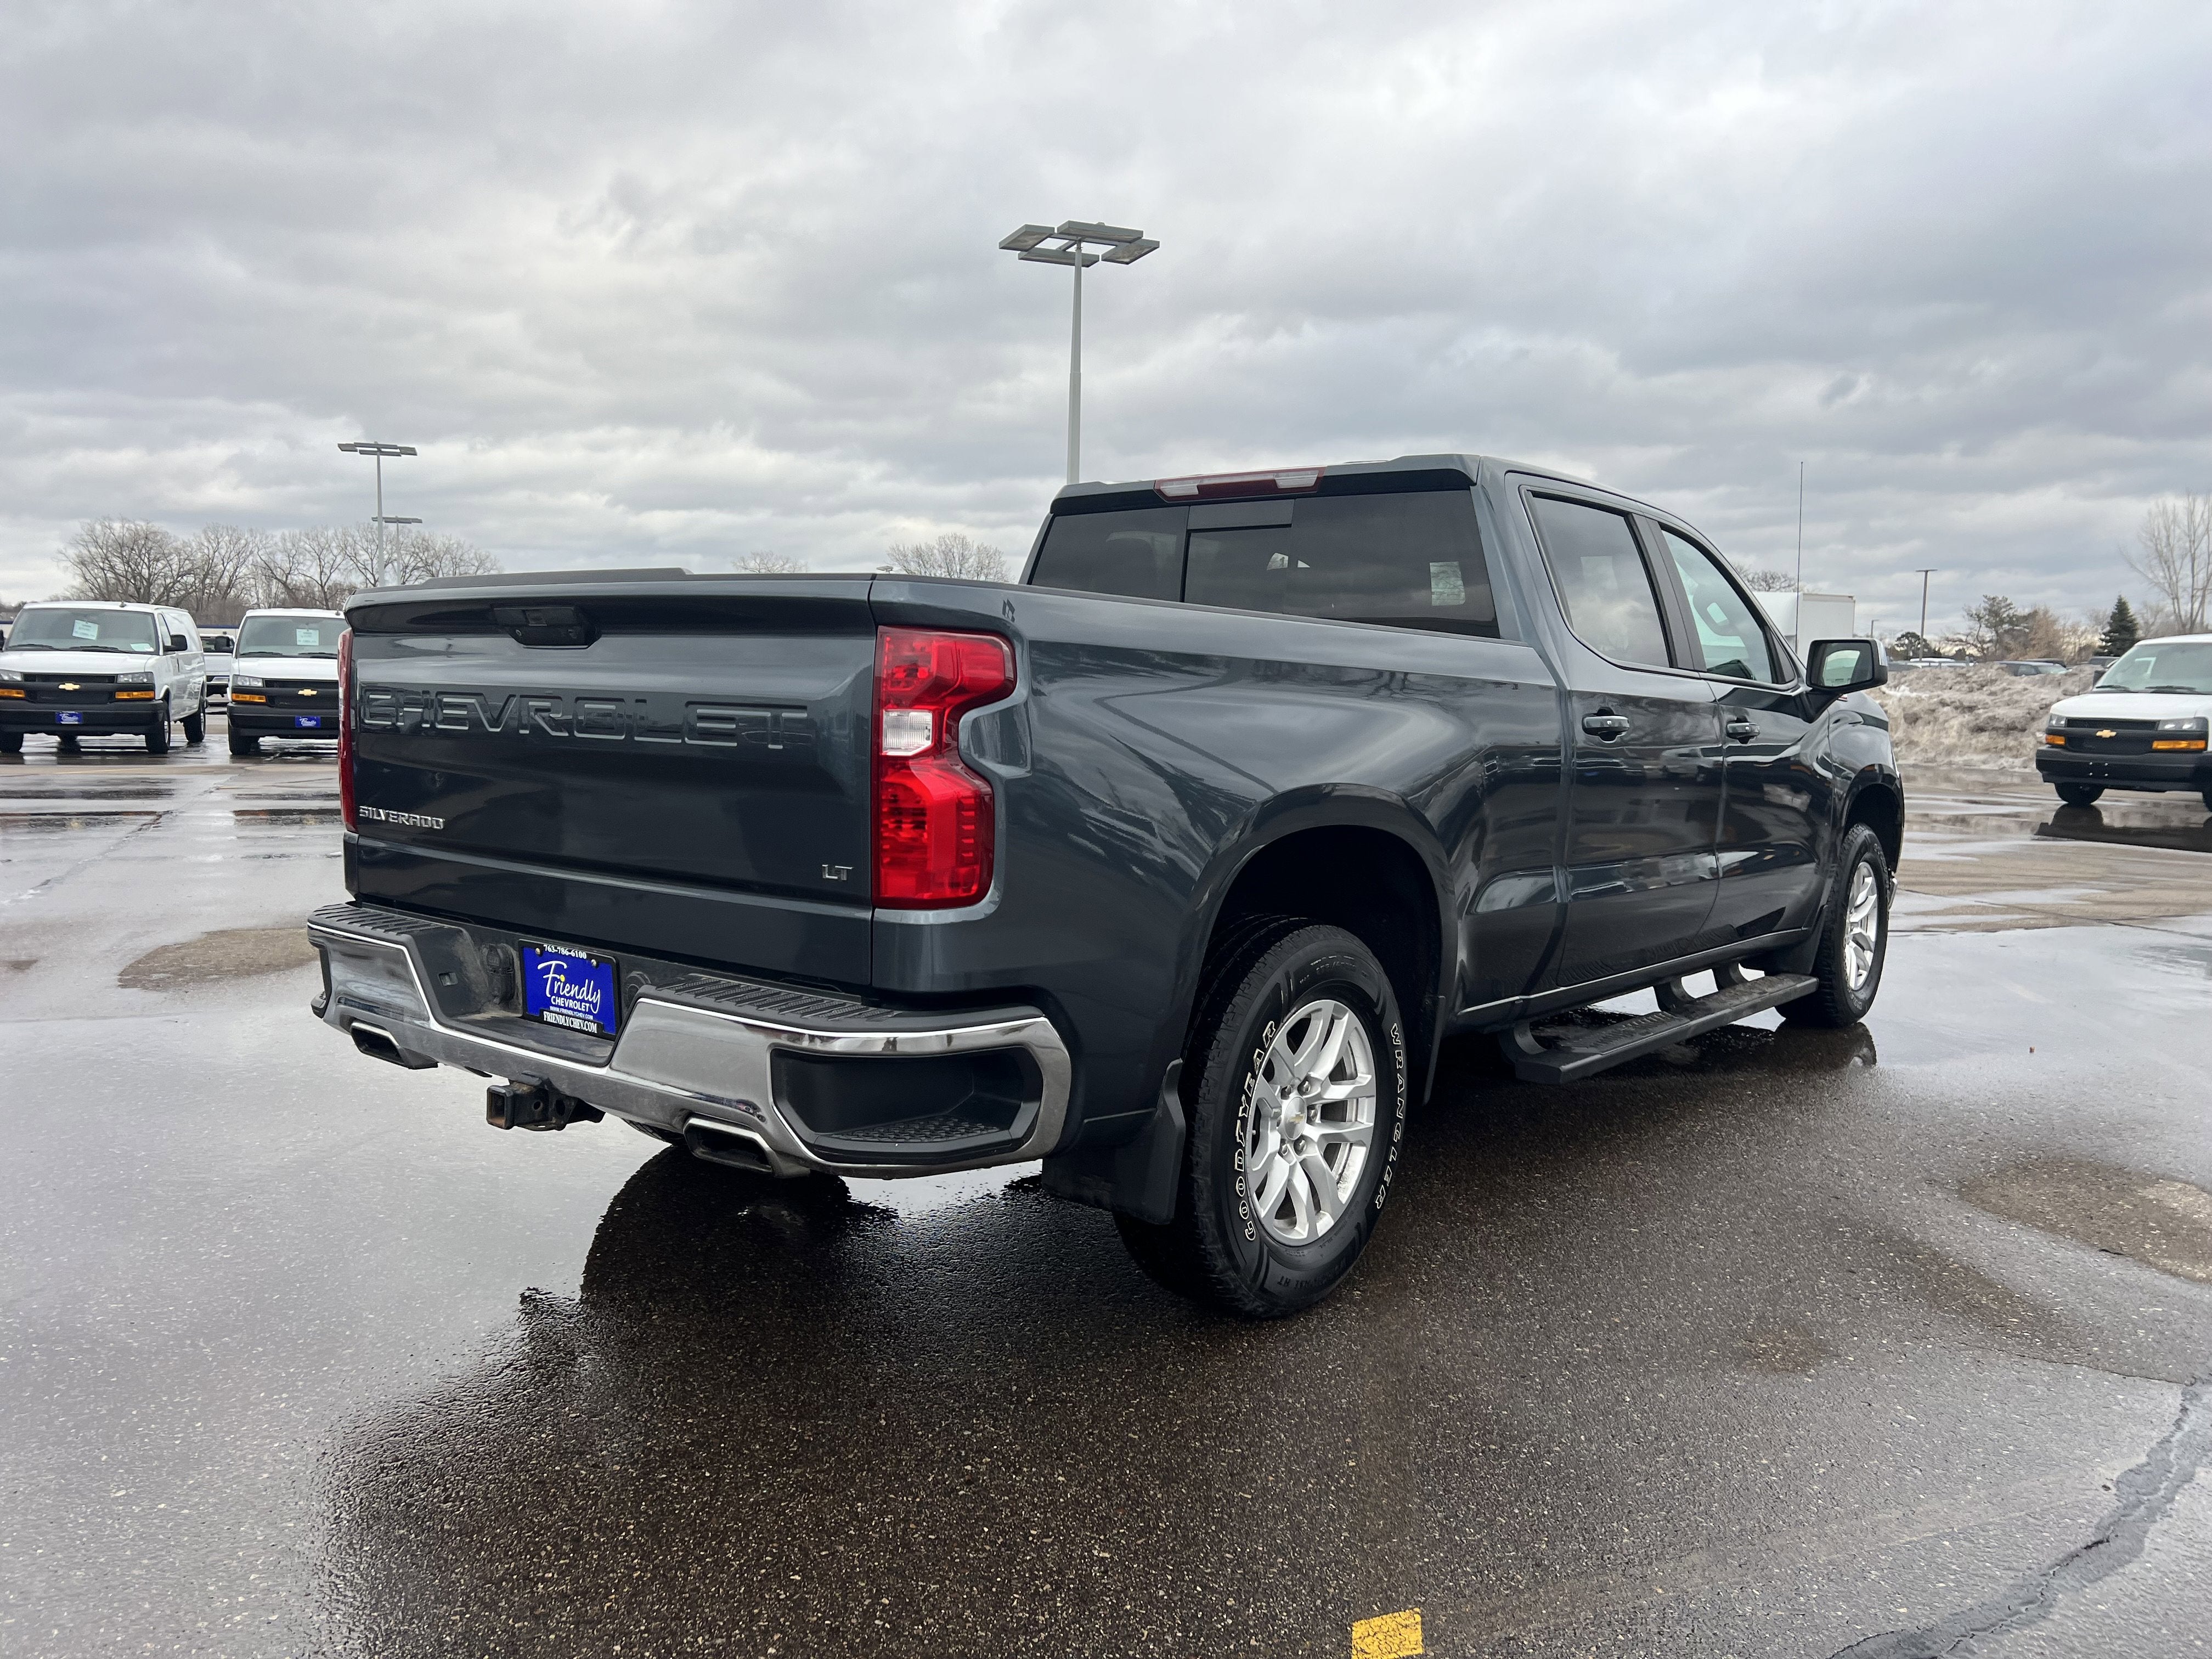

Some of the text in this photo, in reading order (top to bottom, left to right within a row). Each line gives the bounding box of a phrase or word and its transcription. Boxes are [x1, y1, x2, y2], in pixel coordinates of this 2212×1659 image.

[362, 689, 808, 749] CHEVROLET
[359, 805, 445, 830] SILVERADO
[822, 864, 854, 881] LT
[543, 944, 586, 959] 763-786-6100
[537, 961, 600, 1013] Friendly
[551, 996, 590, 1012] CHEVROLET
[543, 1011, 597, 1033] FRIENDLYCHEV.COM
[1375, 1023, 1404, 1209] WRANGLER
[1235, 1021, 1274, 1241] GOODYEAR
